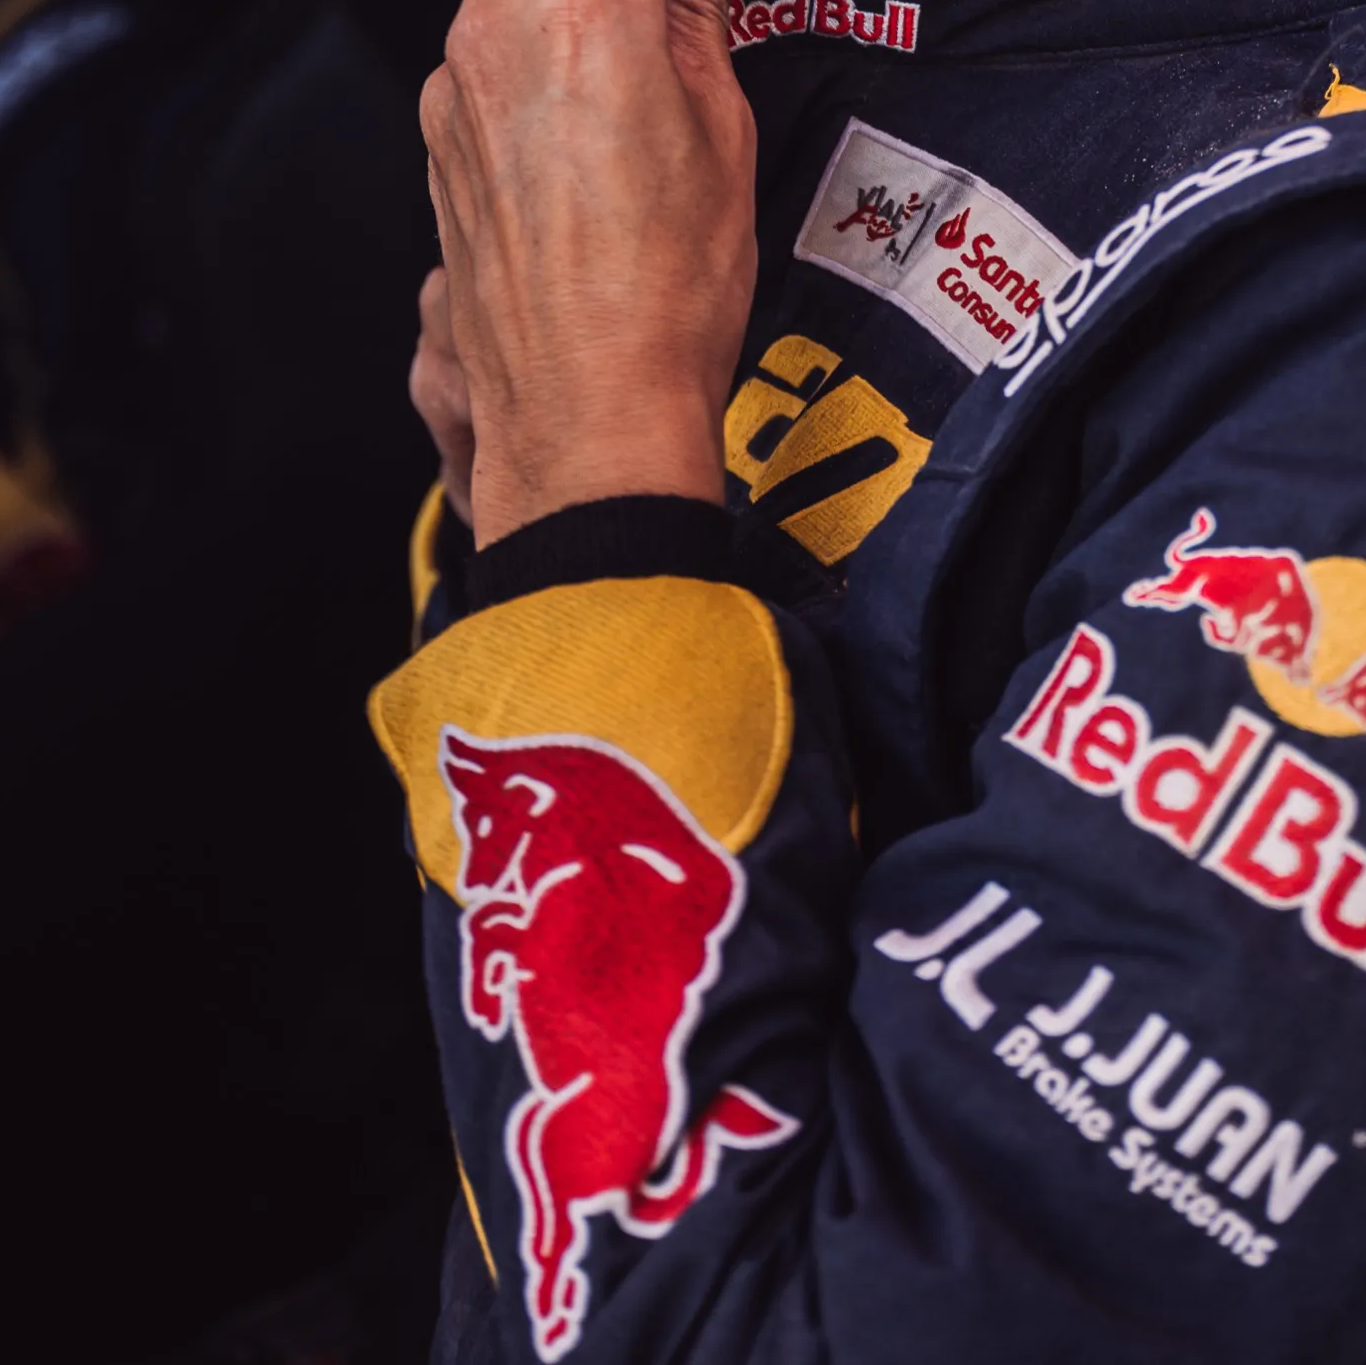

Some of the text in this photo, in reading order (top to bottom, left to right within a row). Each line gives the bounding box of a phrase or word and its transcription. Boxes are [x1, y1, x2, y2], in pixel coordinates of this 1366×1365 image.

[1003, 623, 1275, 858] Red
[992, 1023, 1279, 1269] Brake Systems
